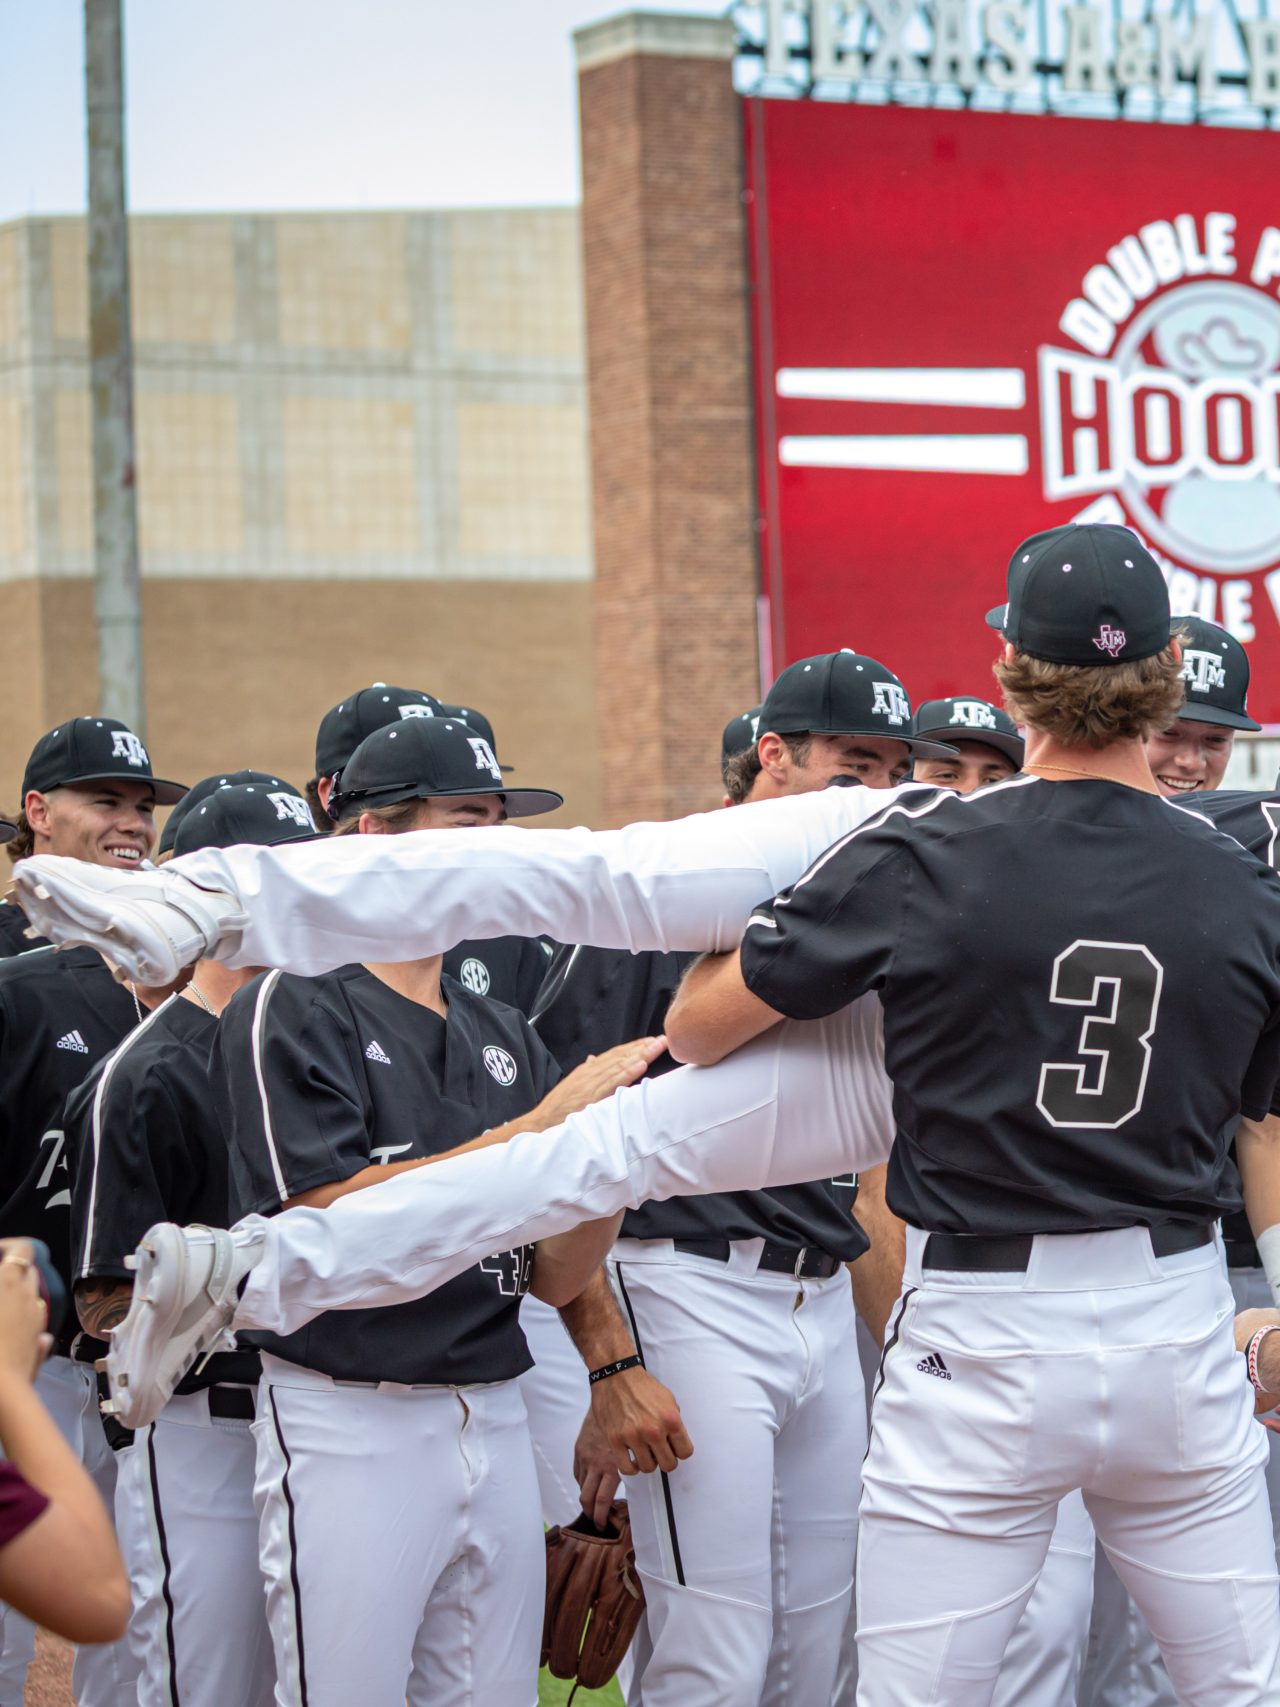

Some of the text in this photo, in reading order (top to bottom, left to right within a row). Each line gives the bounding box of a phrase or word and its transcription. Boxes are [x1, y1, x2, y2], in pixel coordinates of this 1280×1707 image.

[1063, 8, 1219, 98] A&M
[1060, 212, 1237, 355] DOUBLE
[485, 1048, 513, 1083] SEC
[1036, 939, 1164, 1130] 3
[916, 1363, 952, 1381] adidas
